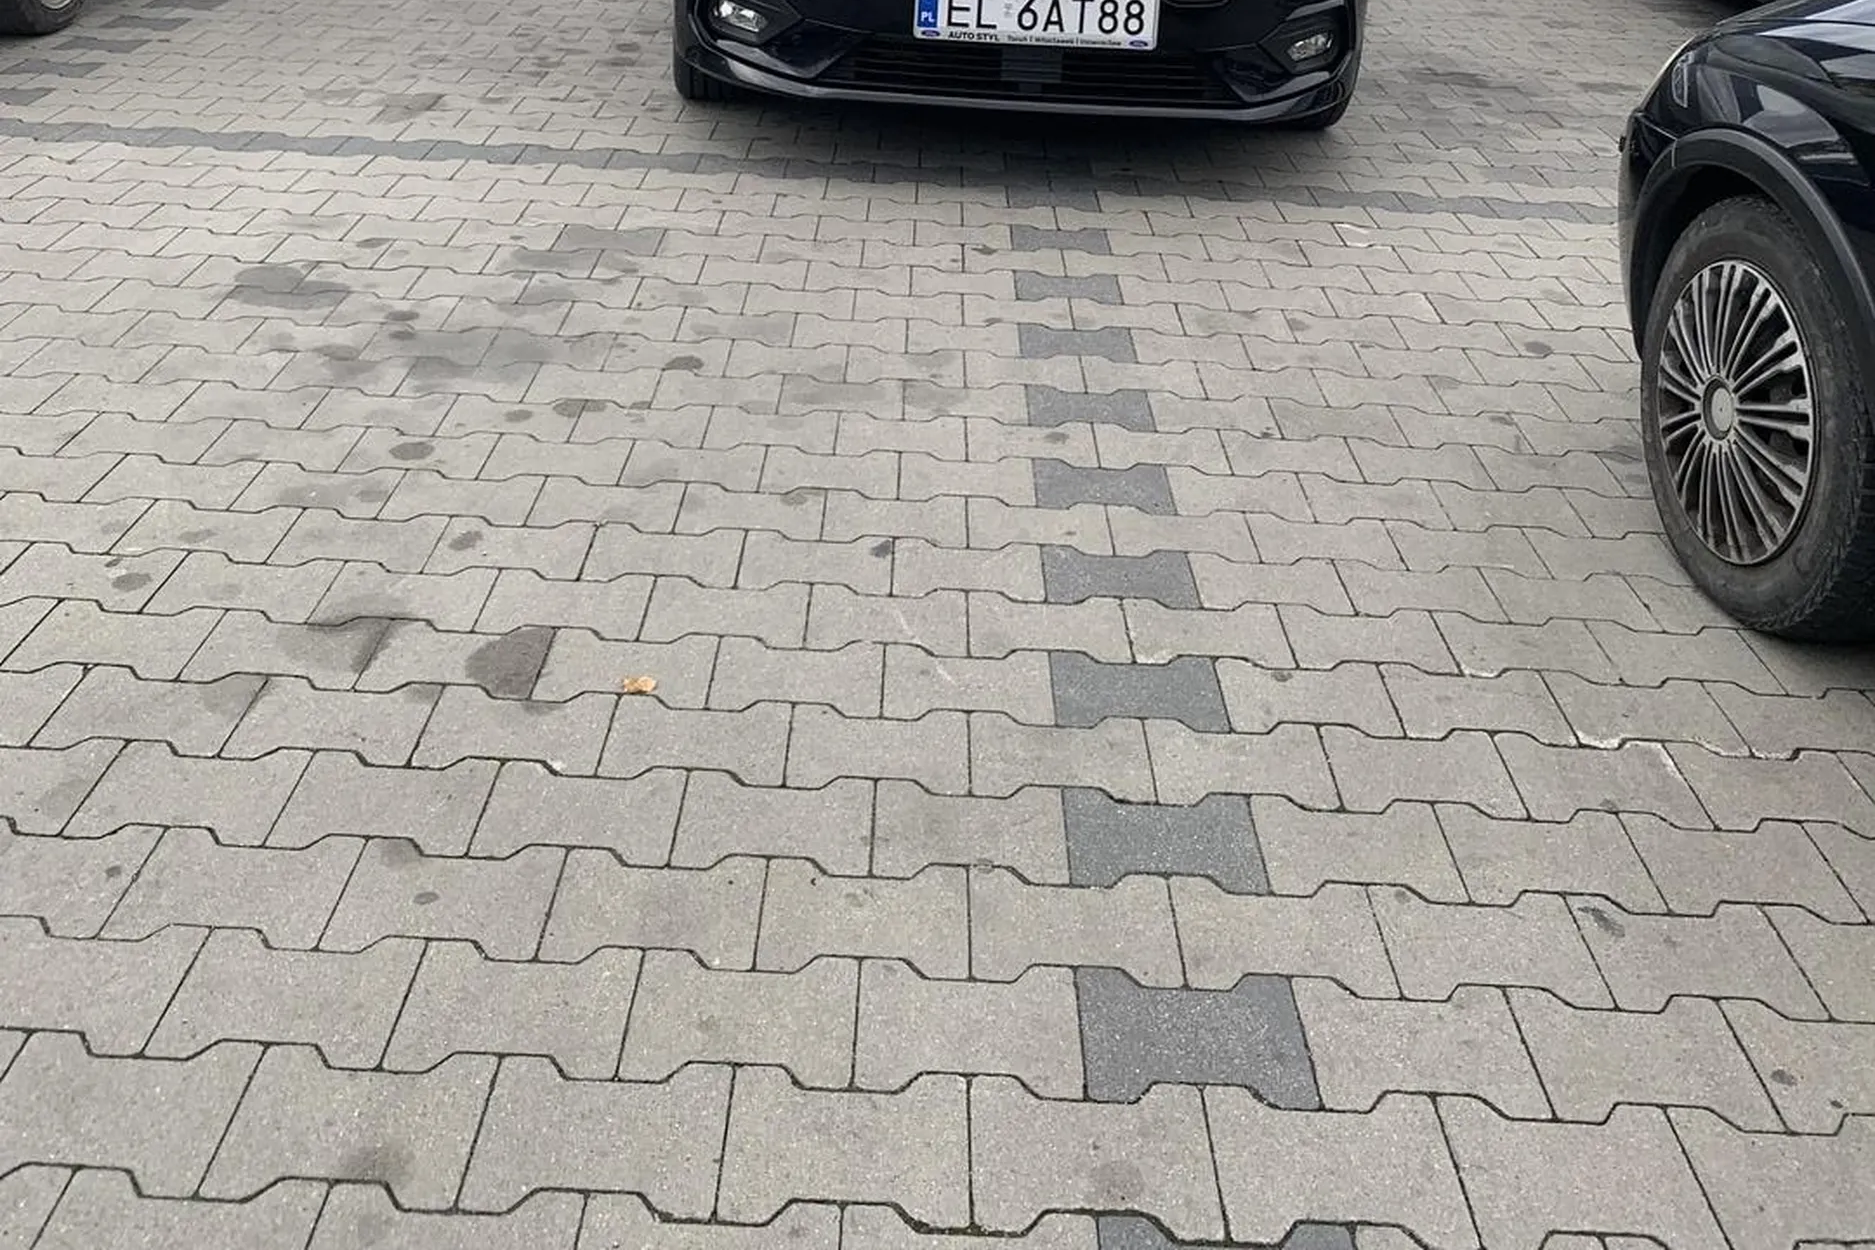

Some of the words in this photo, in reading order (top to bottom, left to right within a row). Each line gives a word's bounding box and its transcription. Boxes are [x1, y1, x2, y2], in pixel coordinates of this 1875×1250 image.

[920, 10, 937, 23] PL
[948, 31, 975, 40] AUTO
[976, 32, 1000, 42] STYL
